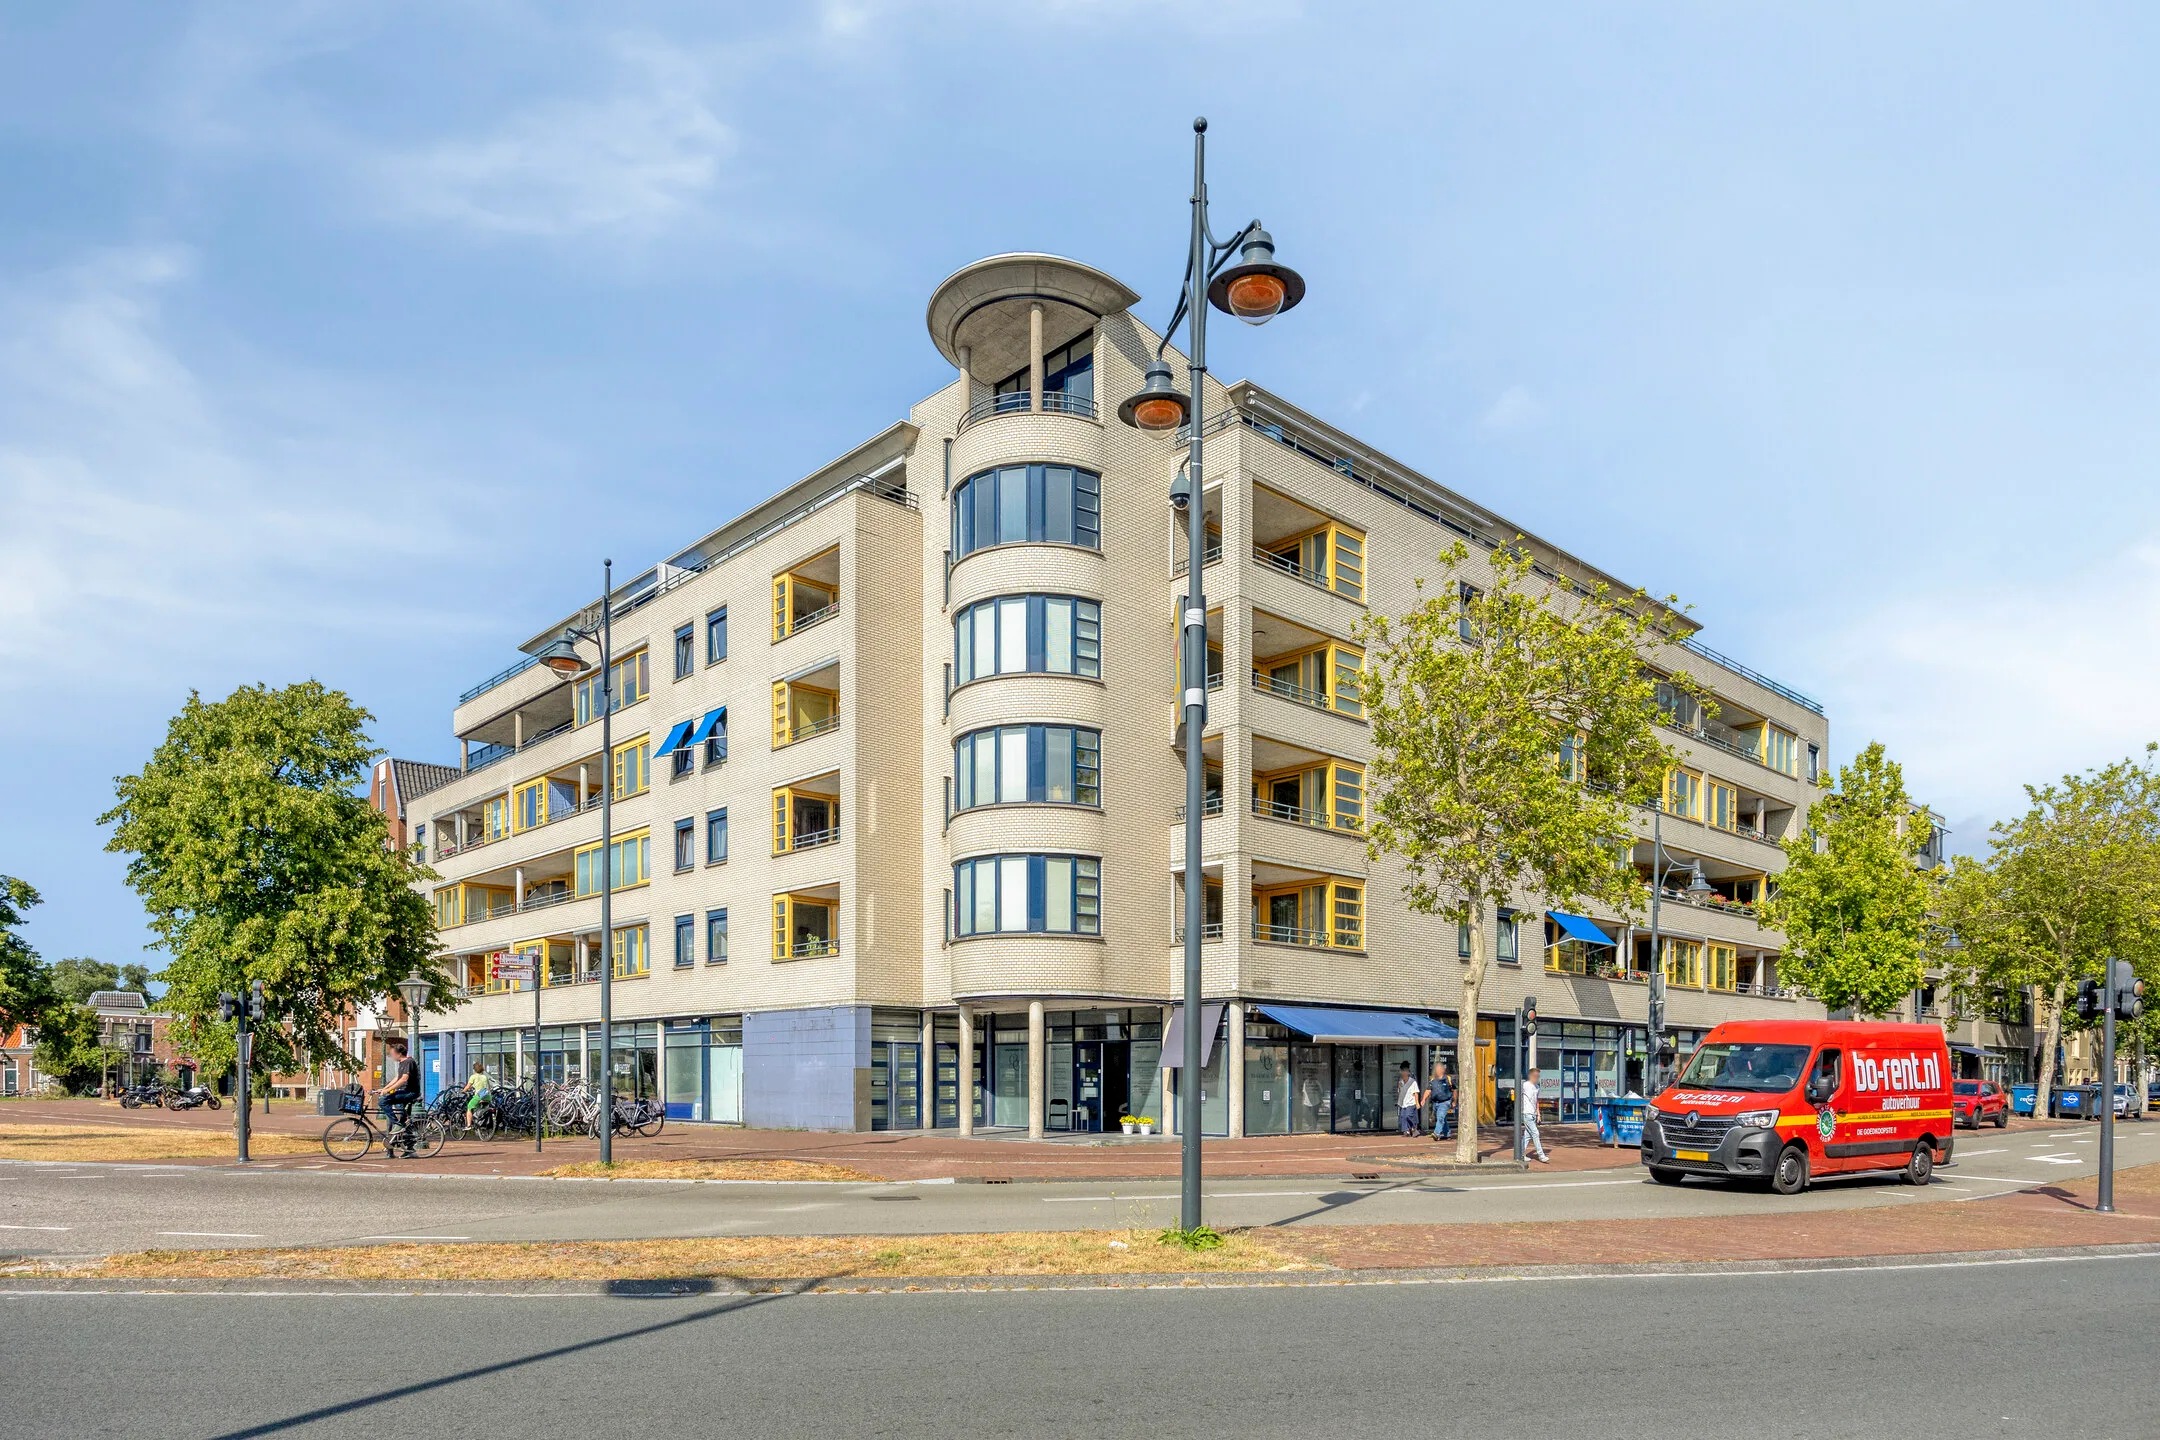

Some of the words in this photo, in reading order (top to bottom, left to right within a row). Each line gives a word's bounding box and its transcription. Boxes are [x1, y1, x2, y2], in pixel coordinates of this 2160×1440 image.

[1852, 1051, 1941, 1092] bo-rent.nl
[1672, 1093, 1746, 1104] bo-rent.nl
[1882, 1095, 1920, 1111] autoverhuur
[1856, 1128, 1863, 1136] DE
[1863, 1126, 1893, 1135] GOEDKOOPSTE
